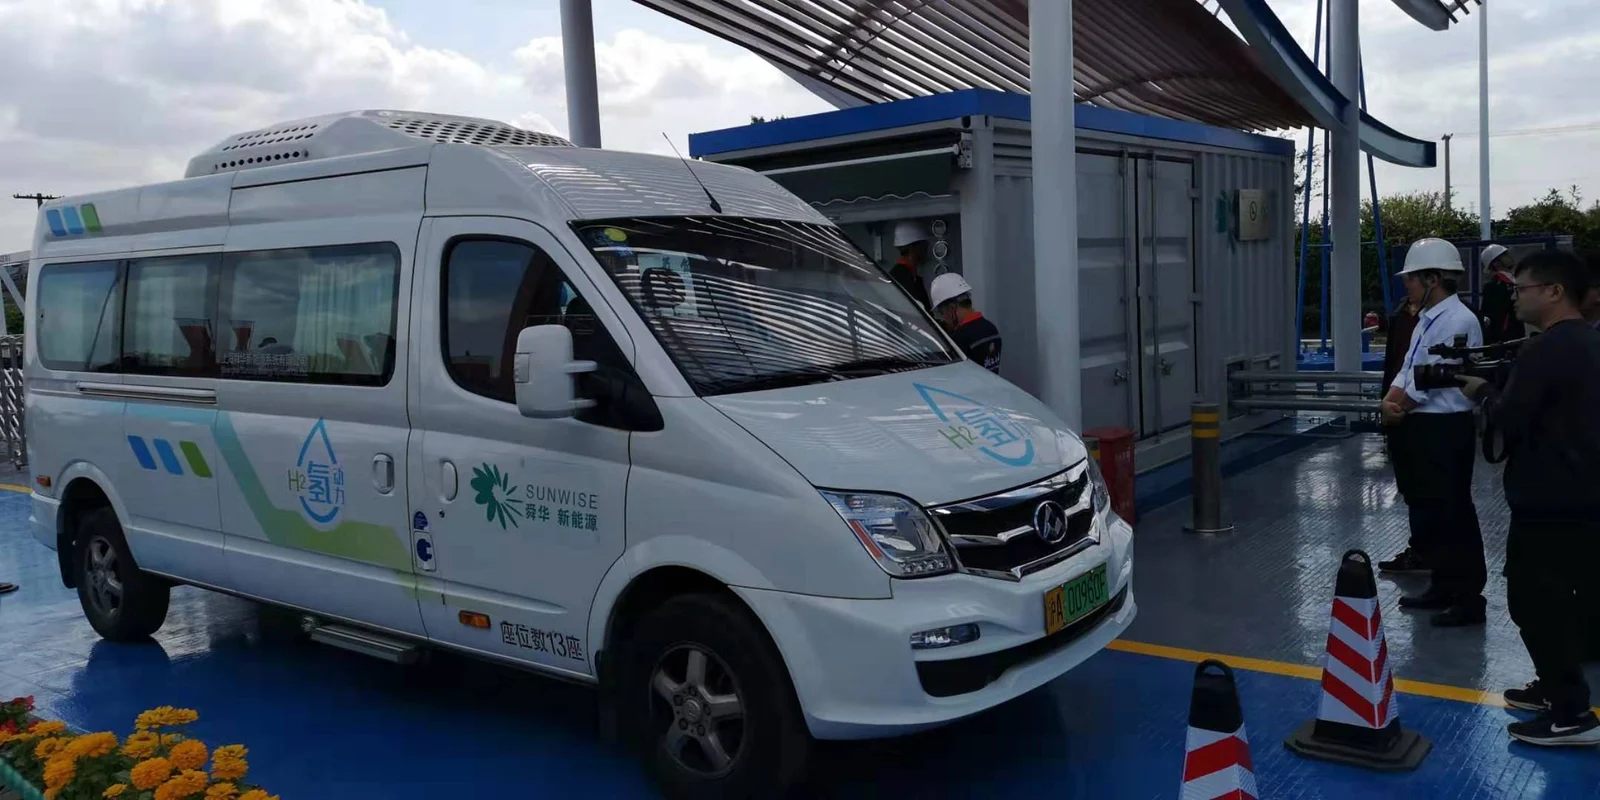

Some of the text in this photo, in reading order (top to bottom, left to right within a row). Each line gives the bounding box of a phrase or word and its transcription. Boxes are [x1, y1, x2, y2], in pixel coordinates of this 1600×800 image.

[937, 425, 979, 450] H2
[287, 469, 306, 492] H2
[307, 460, 332, 504] 氢
[526, 484, 599, 510] SUNWISE
[525, 503, 599, 531] 舜华 新能源
[500, 621, 584, 662] 座位数13座
